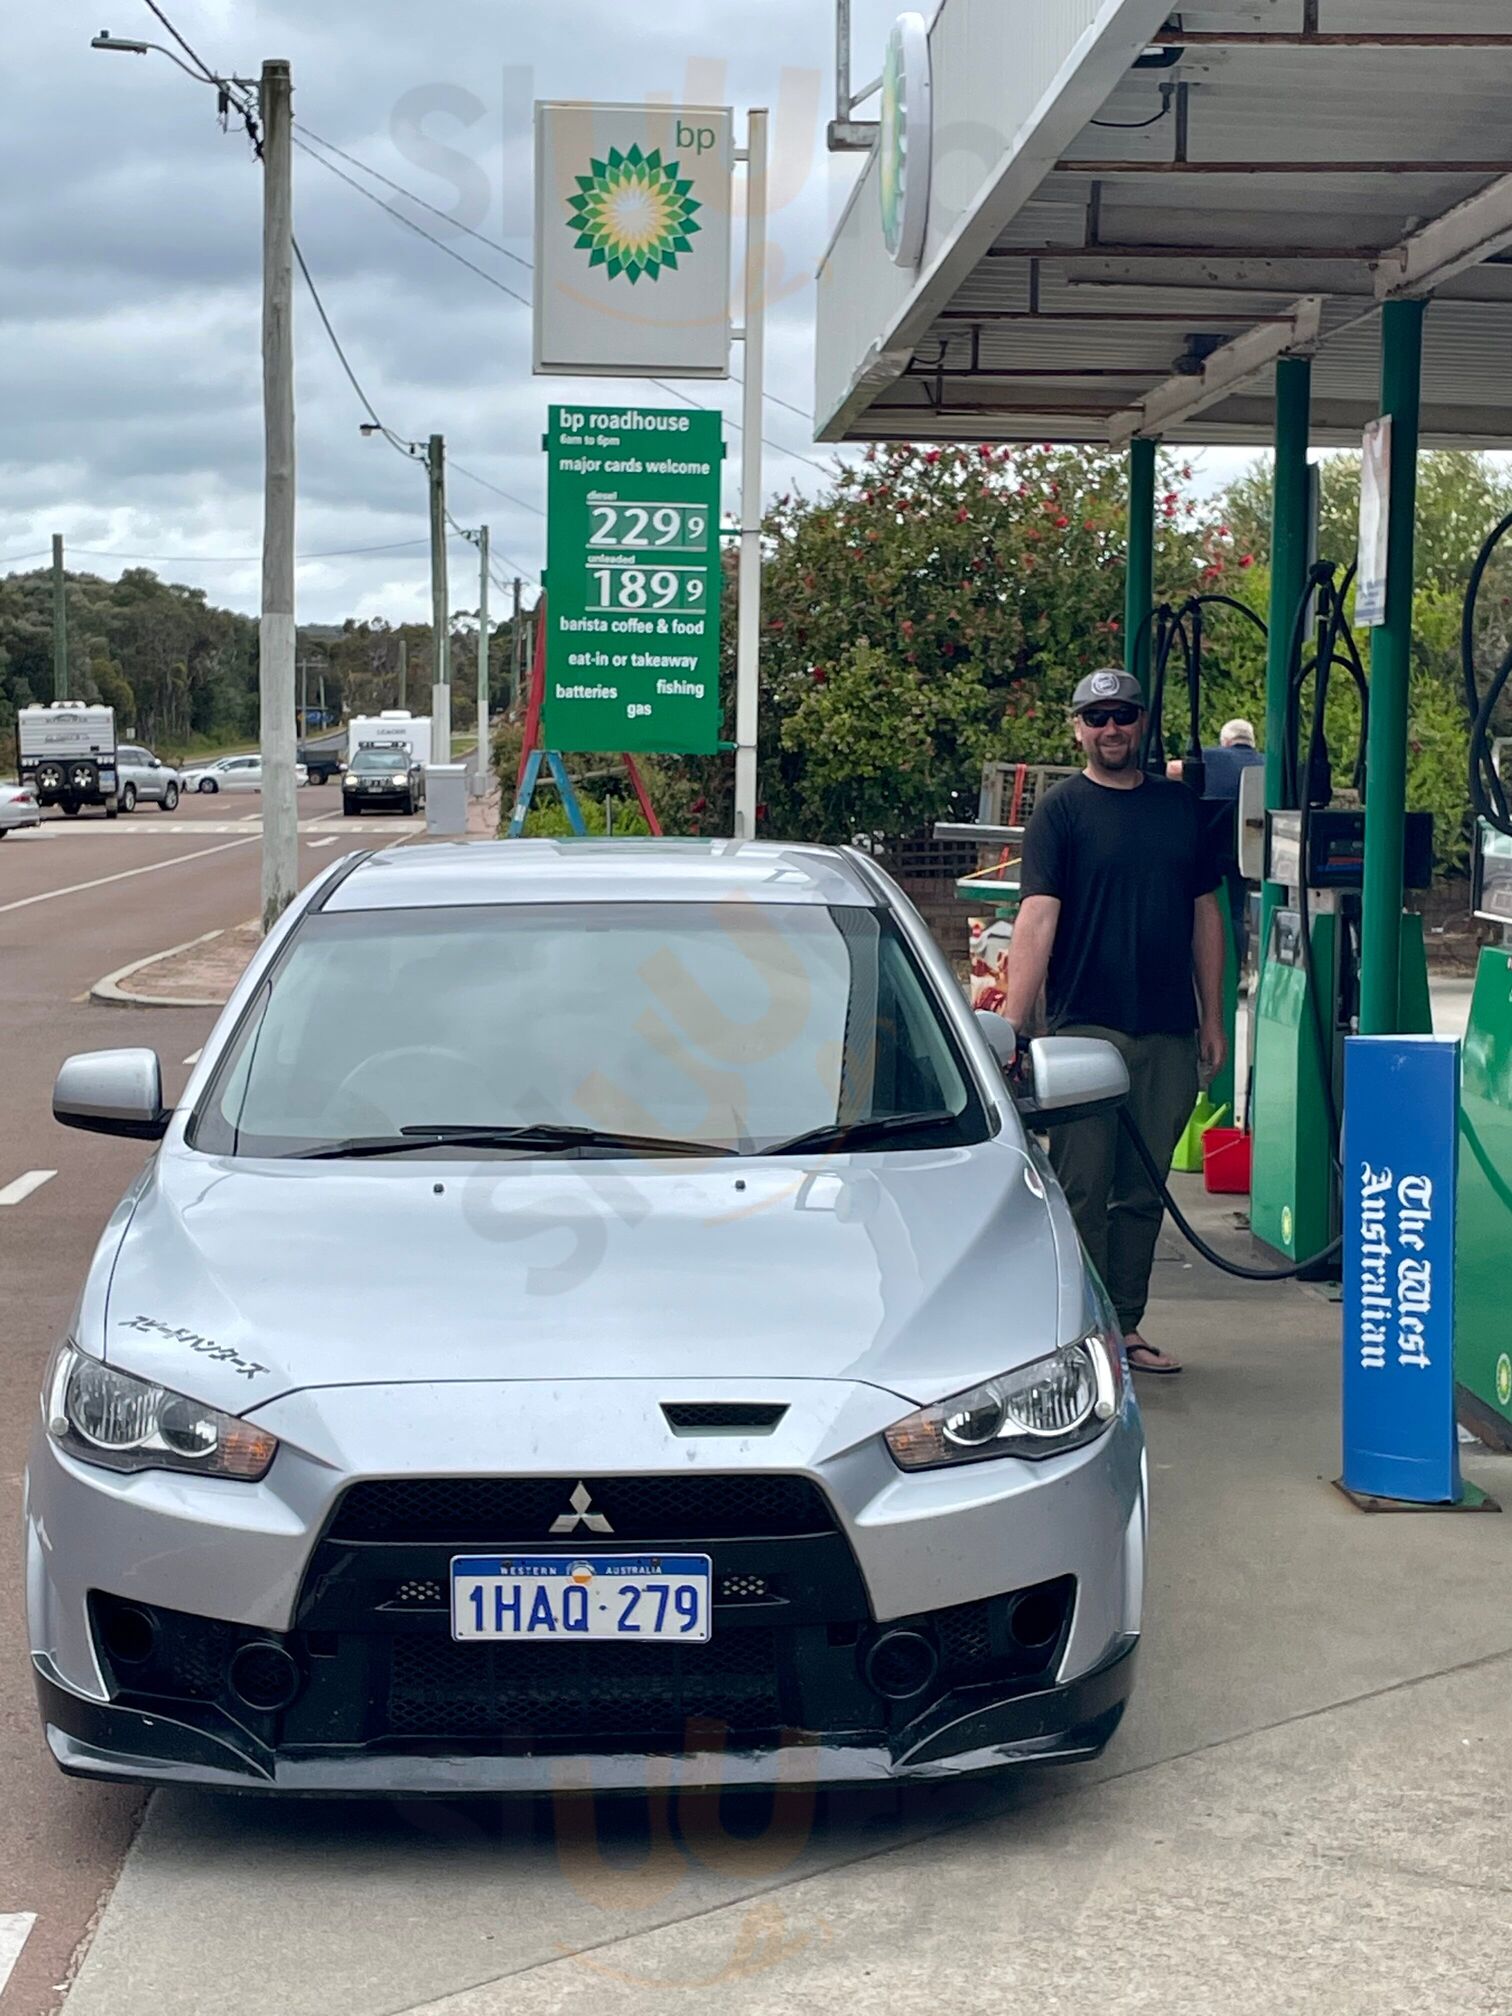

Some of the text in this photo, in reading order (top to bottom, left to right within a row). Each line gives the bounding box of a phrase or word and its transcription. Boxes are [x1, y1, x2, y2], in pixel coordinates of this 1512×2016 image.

[676, 120, 716, 155] bp
[559, 408, 690, 432] bp roadhouse
[559, 433, 621, 447] 6am to 6pm
[559, 456, 711, 475] major cards welcome
[587, 554, 636, 563] unleaded
[559, 616, 704, 635] barista coffee & food
[568, 652, 698, 671] eat-in or takeaway
[556, 679, 704, 699] batteries fishing
[627, 703, 652, 719] gas
[1360, 1161, 1393, 1370] Australian
[1396, 1174, 1433, 1370] The West
[500, 1565, 663, 1576] WESTERN AUSTRALIA
